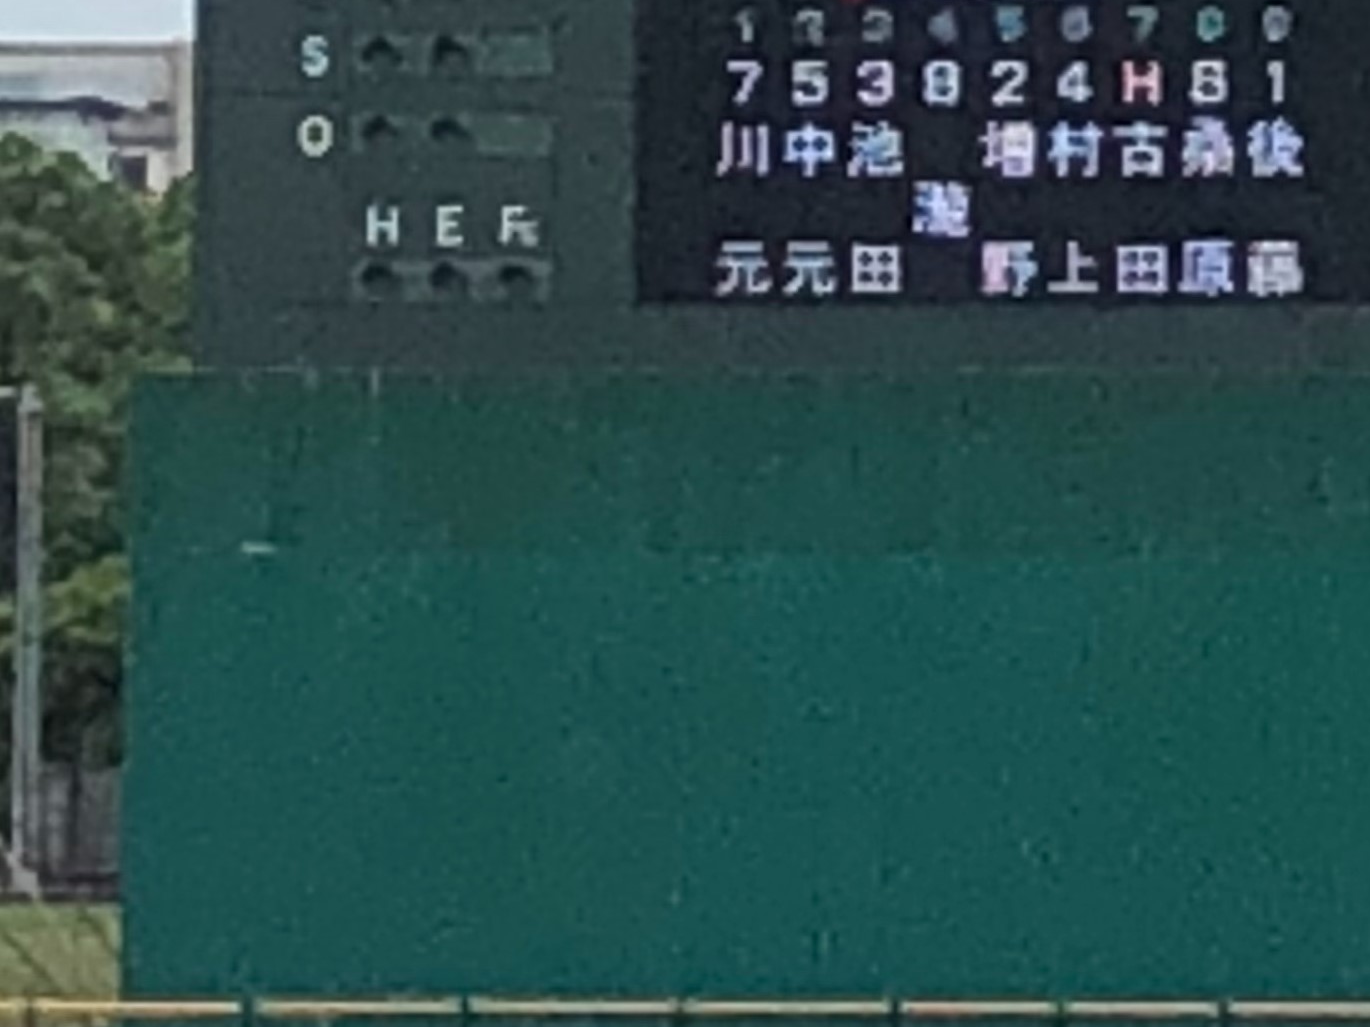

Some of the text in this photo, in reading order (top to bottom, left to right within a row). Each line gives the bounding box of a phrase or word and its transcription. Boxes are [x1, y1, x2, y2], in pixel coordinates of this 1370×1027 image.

[736, 10, 754, 43] 1
[1127, 5, 1159, 41] 7
[302, 35, 329, 77] S
[727, 60, 763, 104] 7
[792, 60, 829, 106] 5
[857, 60, 894, 106] 3
[991, 60, 1028, 107] 2
[1057, 61, 1093, 103] 4
[1123, 61, 1161, 106] H
[1267, 60, 1284, 103] 1
[298, 115, 334, 157] O
[366, 205, 399, 246] H
[436, 204, 464, 247] E
